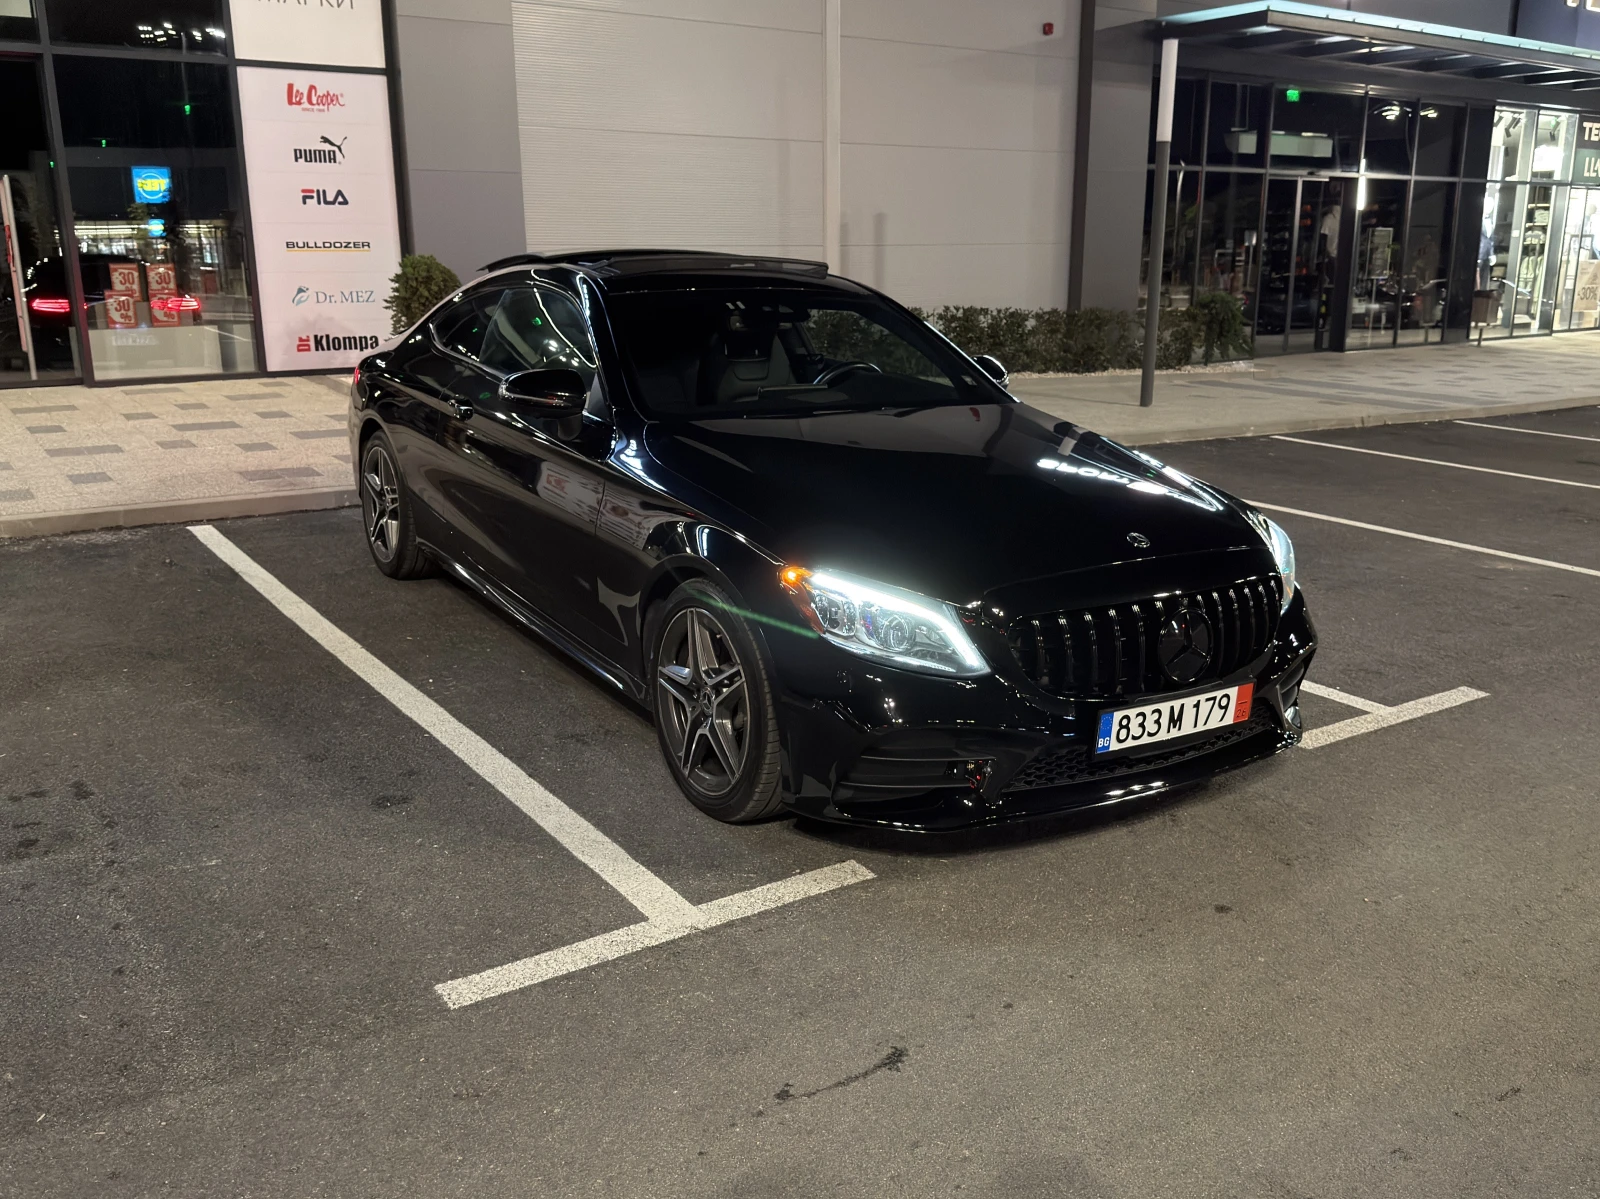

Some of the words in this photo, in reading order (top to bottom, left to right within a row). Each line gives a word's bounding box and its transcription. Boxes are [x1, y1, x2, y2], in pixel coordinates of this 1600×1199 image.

[287, 82, 305, 106] Lee
[306, 84, 345, 112] Cooper
[1583, 121, 1600, 141] TE
[293, 148, 337, 164] PUMA
[301, 189, 349, 205] FILA
[286, 241, 371, 249] BULLDOZER
[315, 291, 337, 304] Dr.
[340, 290, 376, 303] MEZ
[313, 334, 379, 352] Klompa
[1116, 708, 1163, 744] 833
[1166, 702, 1185, 734] M
[1192, 693, 1231, 728] 179
[1236, 708, 1246, 718] 26
[1098, 737, 1110, 748] BG
